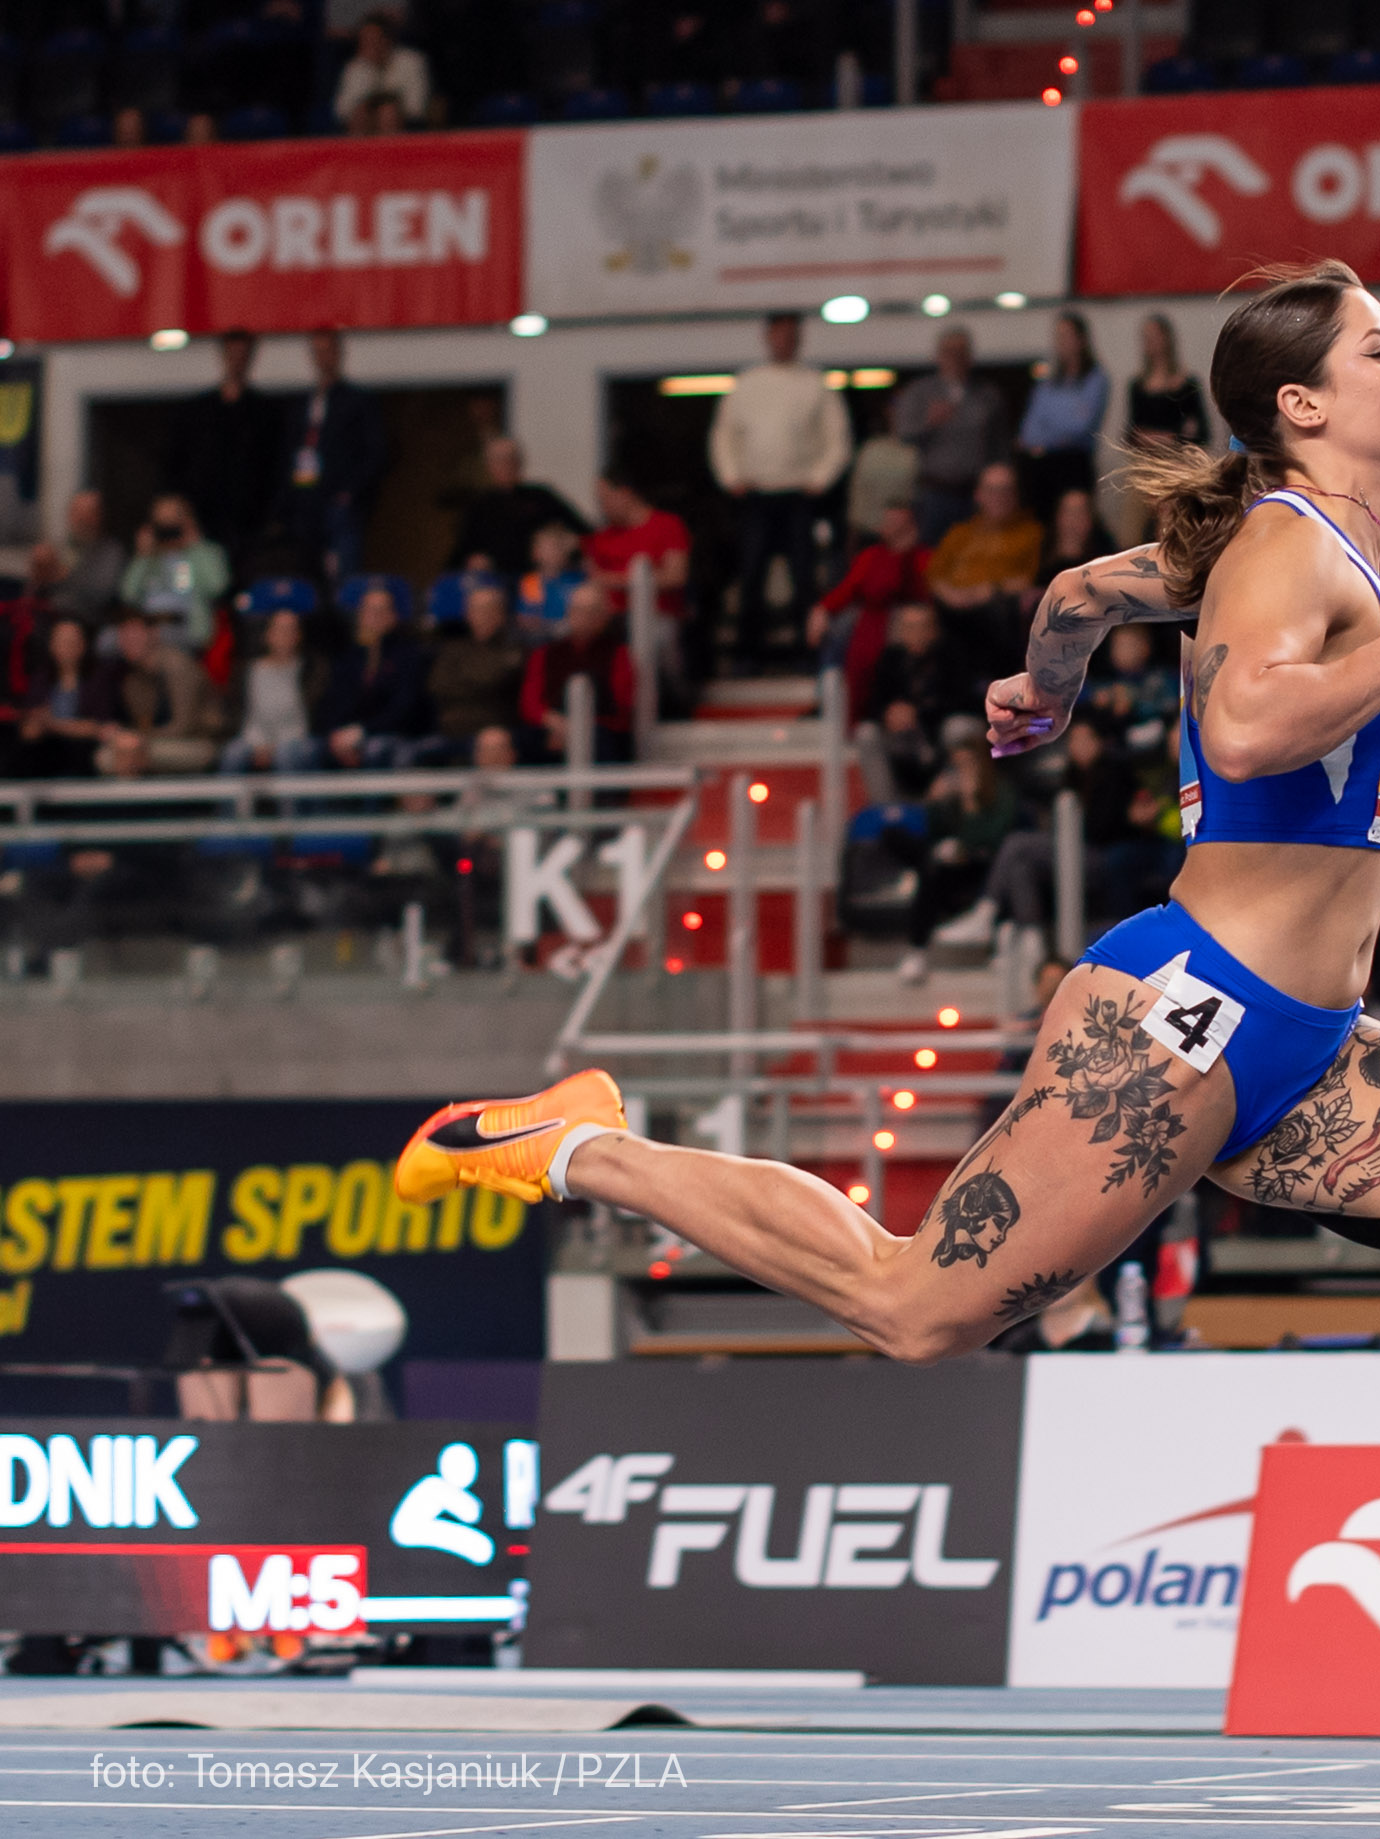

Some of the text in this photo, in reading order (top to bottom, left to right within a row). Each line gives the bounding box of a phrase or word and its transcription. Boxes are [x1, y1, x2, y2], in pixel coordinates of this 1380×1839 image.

[203, 188, 488, 274] ORLEN
[505, 825, 648, 942] K1
[1164, 996, 1223, 1053] 4
[2, 1169, 216, 1274] STEM
[0, 1433, 200, 1529] DNIK
[545, 1453, 676, 1524] 4F
[647, 1484, 1001, 1589] FUEL
